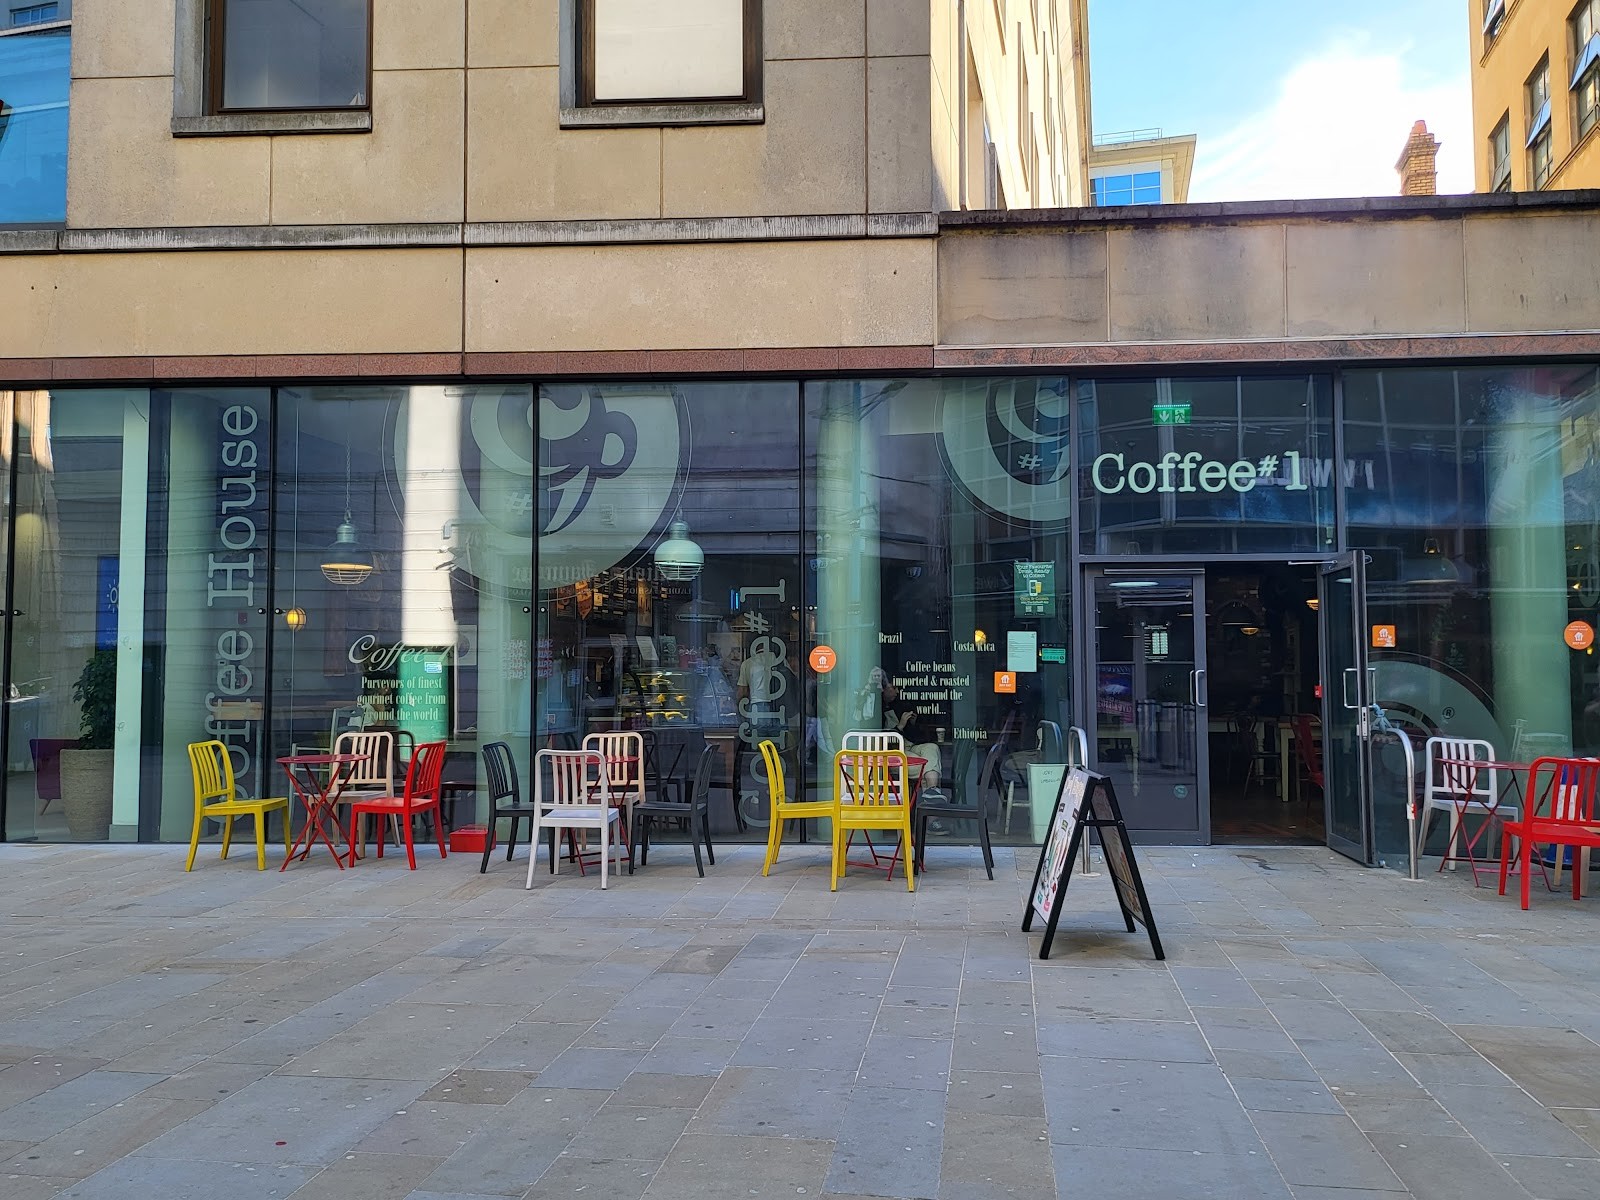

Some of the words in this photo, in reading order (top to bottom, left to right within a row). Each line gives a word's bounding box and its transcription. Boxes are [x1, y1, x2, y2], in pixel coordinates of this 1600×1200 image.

[1092, 451, 1308, 494] Coffee#1
[207, 405, 258, 606] House
[878, 632, 902, 644] Brazil
[953, 640, 976, 652] Costa
[905, 660, 931, 673] Coffee
[932, 660, 956, 673] beans
[361, 676, 404, 689] Purveyors
[407, 676, 416, 689] of
[418, 676, 442, 689] finest
[892, 675, 929, 689] imported
[930, 675, 938, 687] &
[940, 675, 970, 687] roasted
[356, 693, 393, 708] gourmet
[395, 692, 423, 705] coffee
[425, 692, 446, 705] from
[900, 689, 919, 701] from
[920, 689, 948, 701] around
[949, 689, 963, 701] the
[396, 708, 412, 721] the
[413, 708, 439, 721] world
[953, 727, 987, 742] Ethiopia
